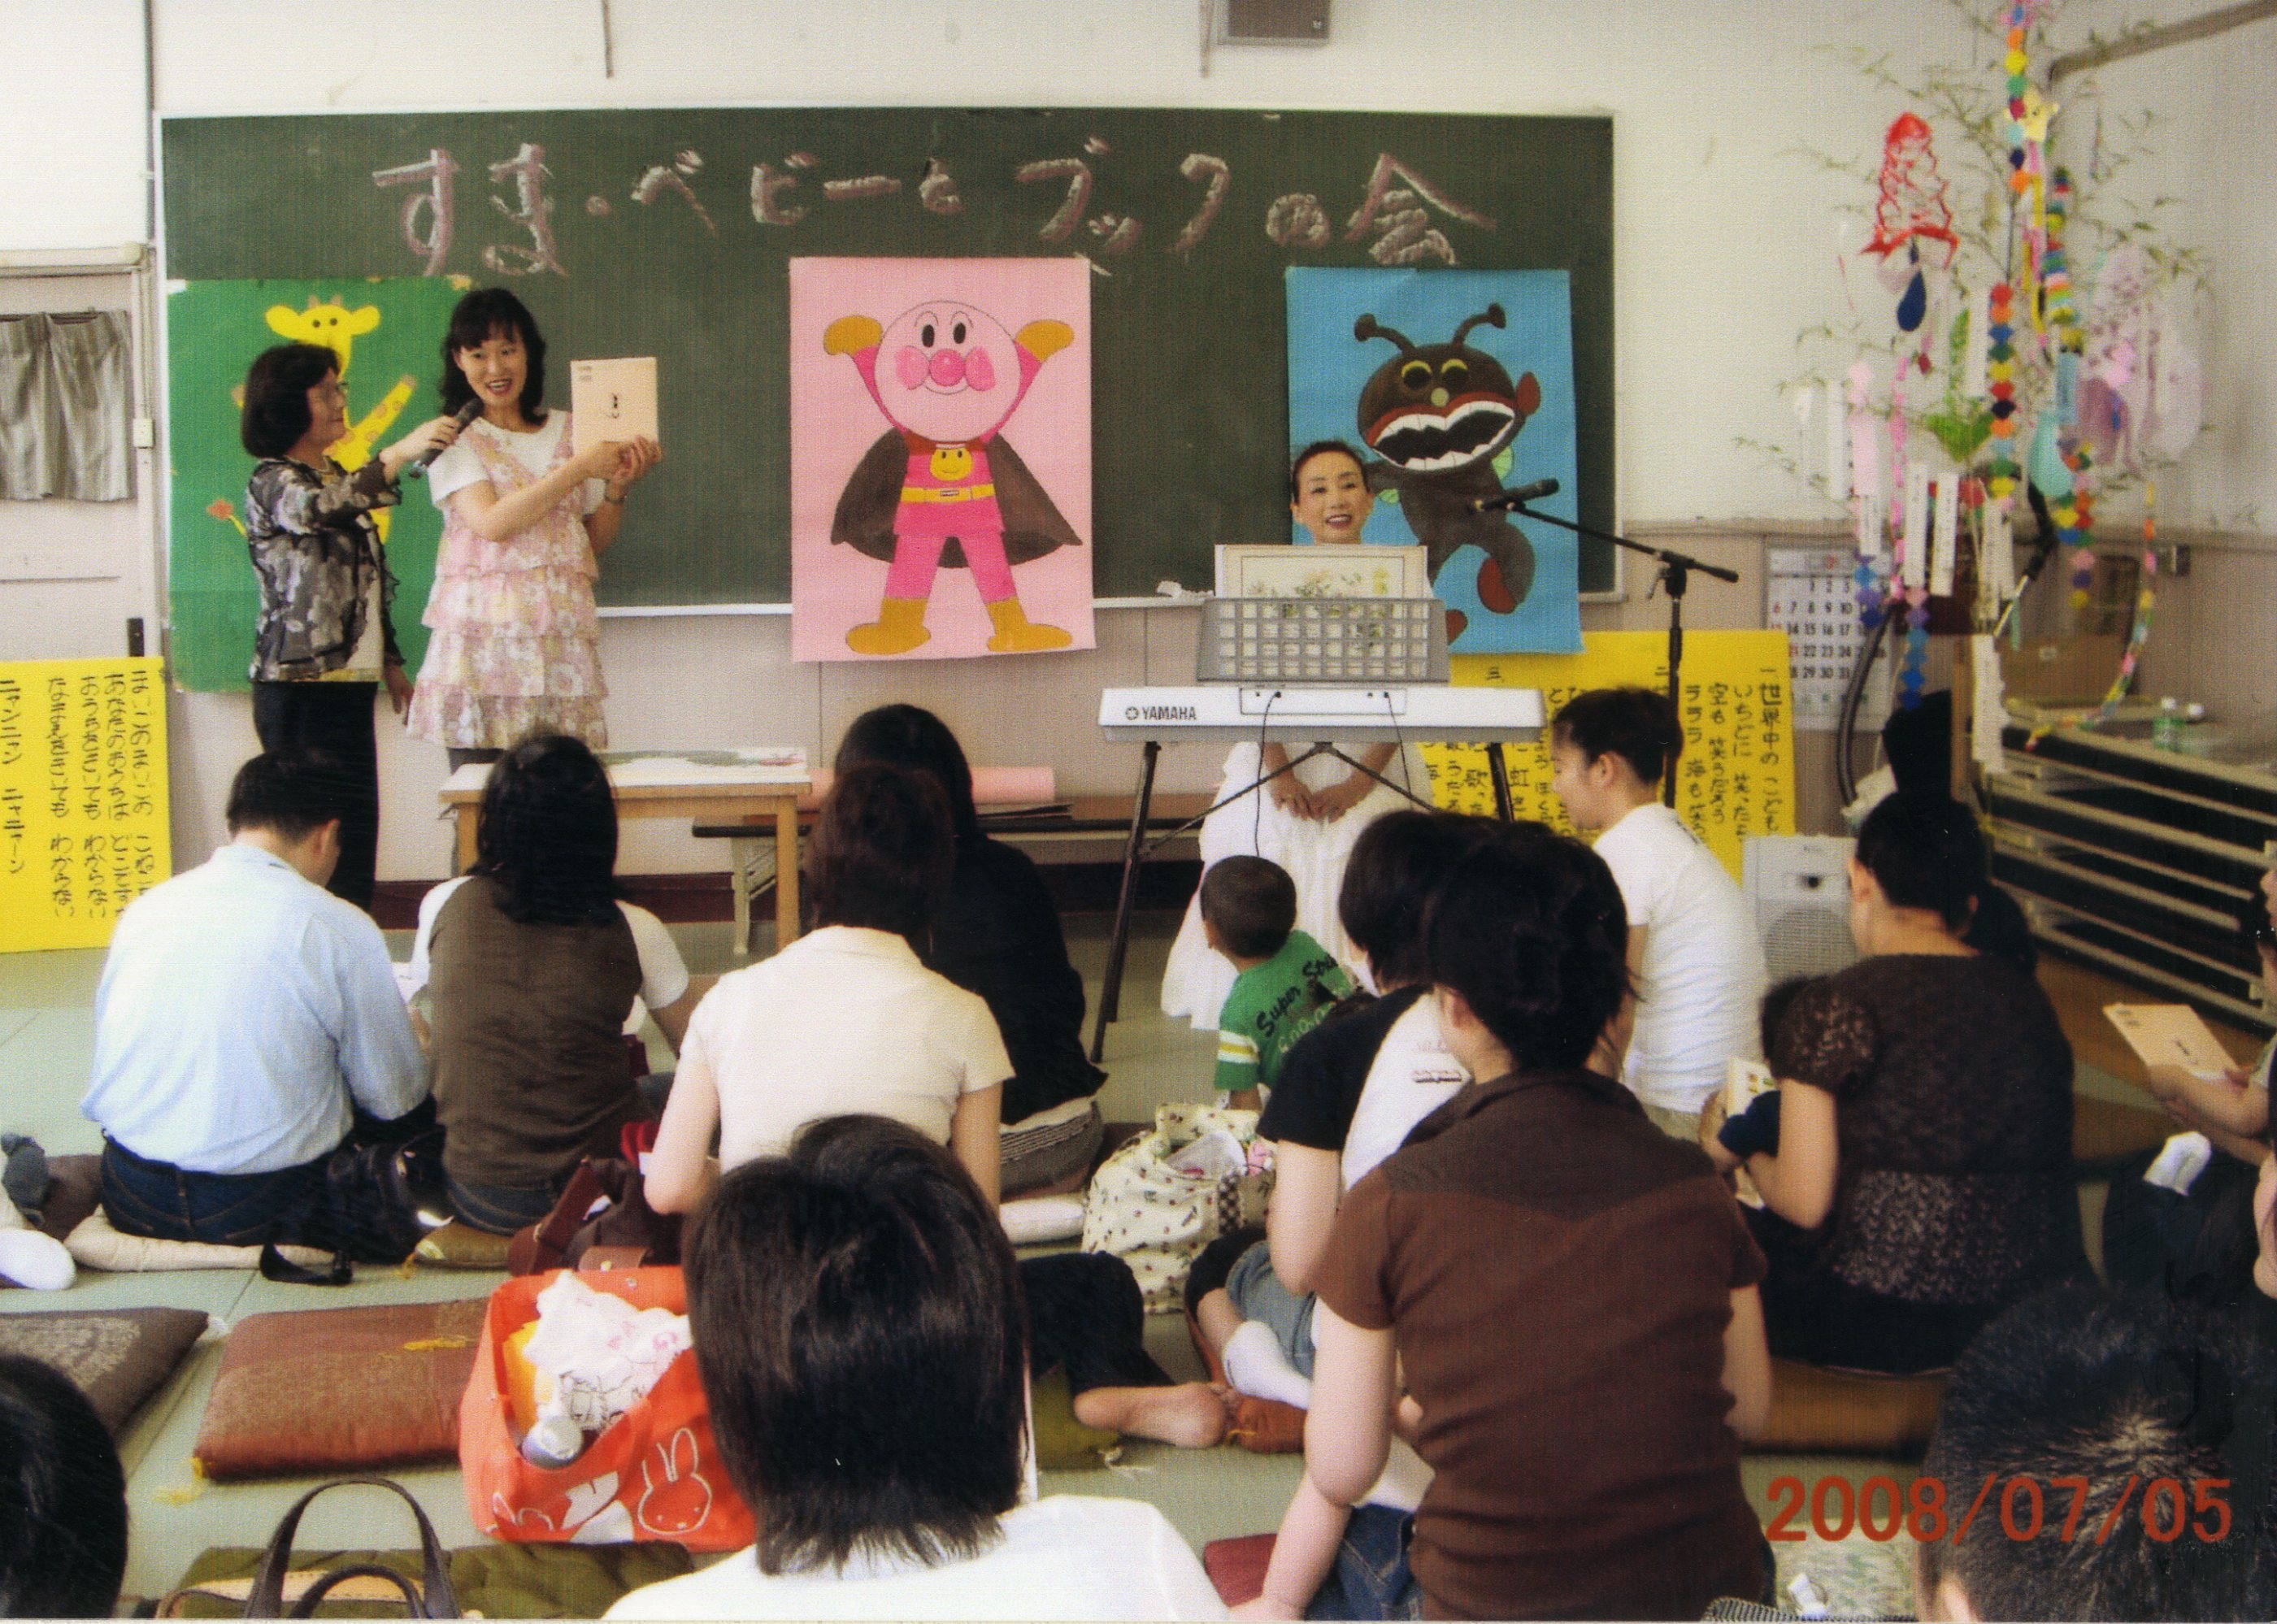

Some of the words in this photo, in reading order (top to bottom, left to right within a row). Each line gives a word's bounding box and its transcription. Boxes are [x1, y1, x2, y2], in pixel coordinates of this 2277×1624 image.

[1808, 601, 1816, 614] 8
[1825, 601, 1832, 614] 9
[1840, 601, 1853, 614] 10
[1787, 623, 1800, 636] 14
[1804, 623, 1817, 636] 15
[1822, 623, 1834, 636] 16
[1839, 623, 1850, 636] 17
[1803, 645, 1817, 658] 22
[1838, 645, 1852, 658] 24
[1803, 667, 1817, 680] 29
[1820, 667, 1834, 680] 30
[1839, 667, 1851, 680] 31
[1142, 706, 1197, 720] YAMAHA
[1685, 684, 1704, 744] ラララ
[1256, 986, 1301, 1038] Super
